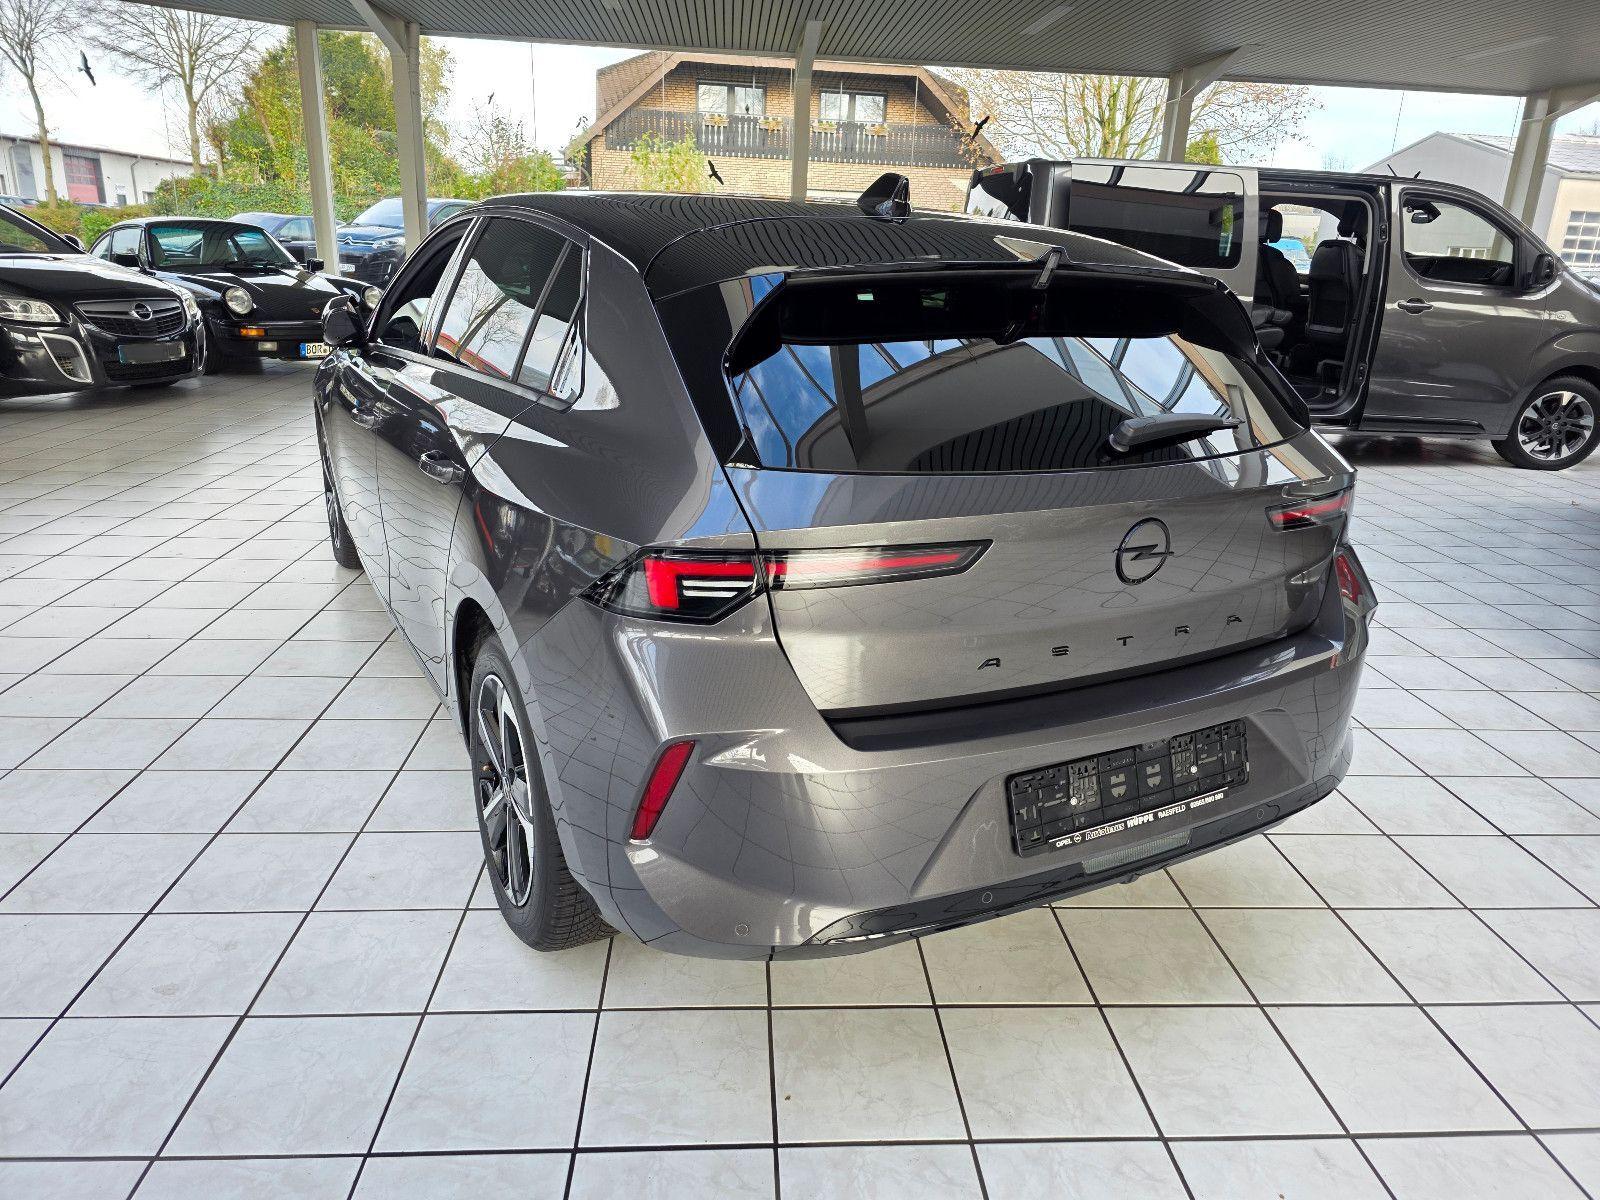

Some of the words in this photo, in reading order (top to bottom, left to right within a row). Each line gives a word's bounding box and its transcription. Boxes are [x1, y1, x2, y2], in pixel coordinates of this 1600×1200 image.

[306, 344, 323, 355] BOR
[977, 614, 1243, 671] ASTRA
[1056, 839, 1073, 848] OPEL
[1085, 823, 1125, 841] Autohaus
